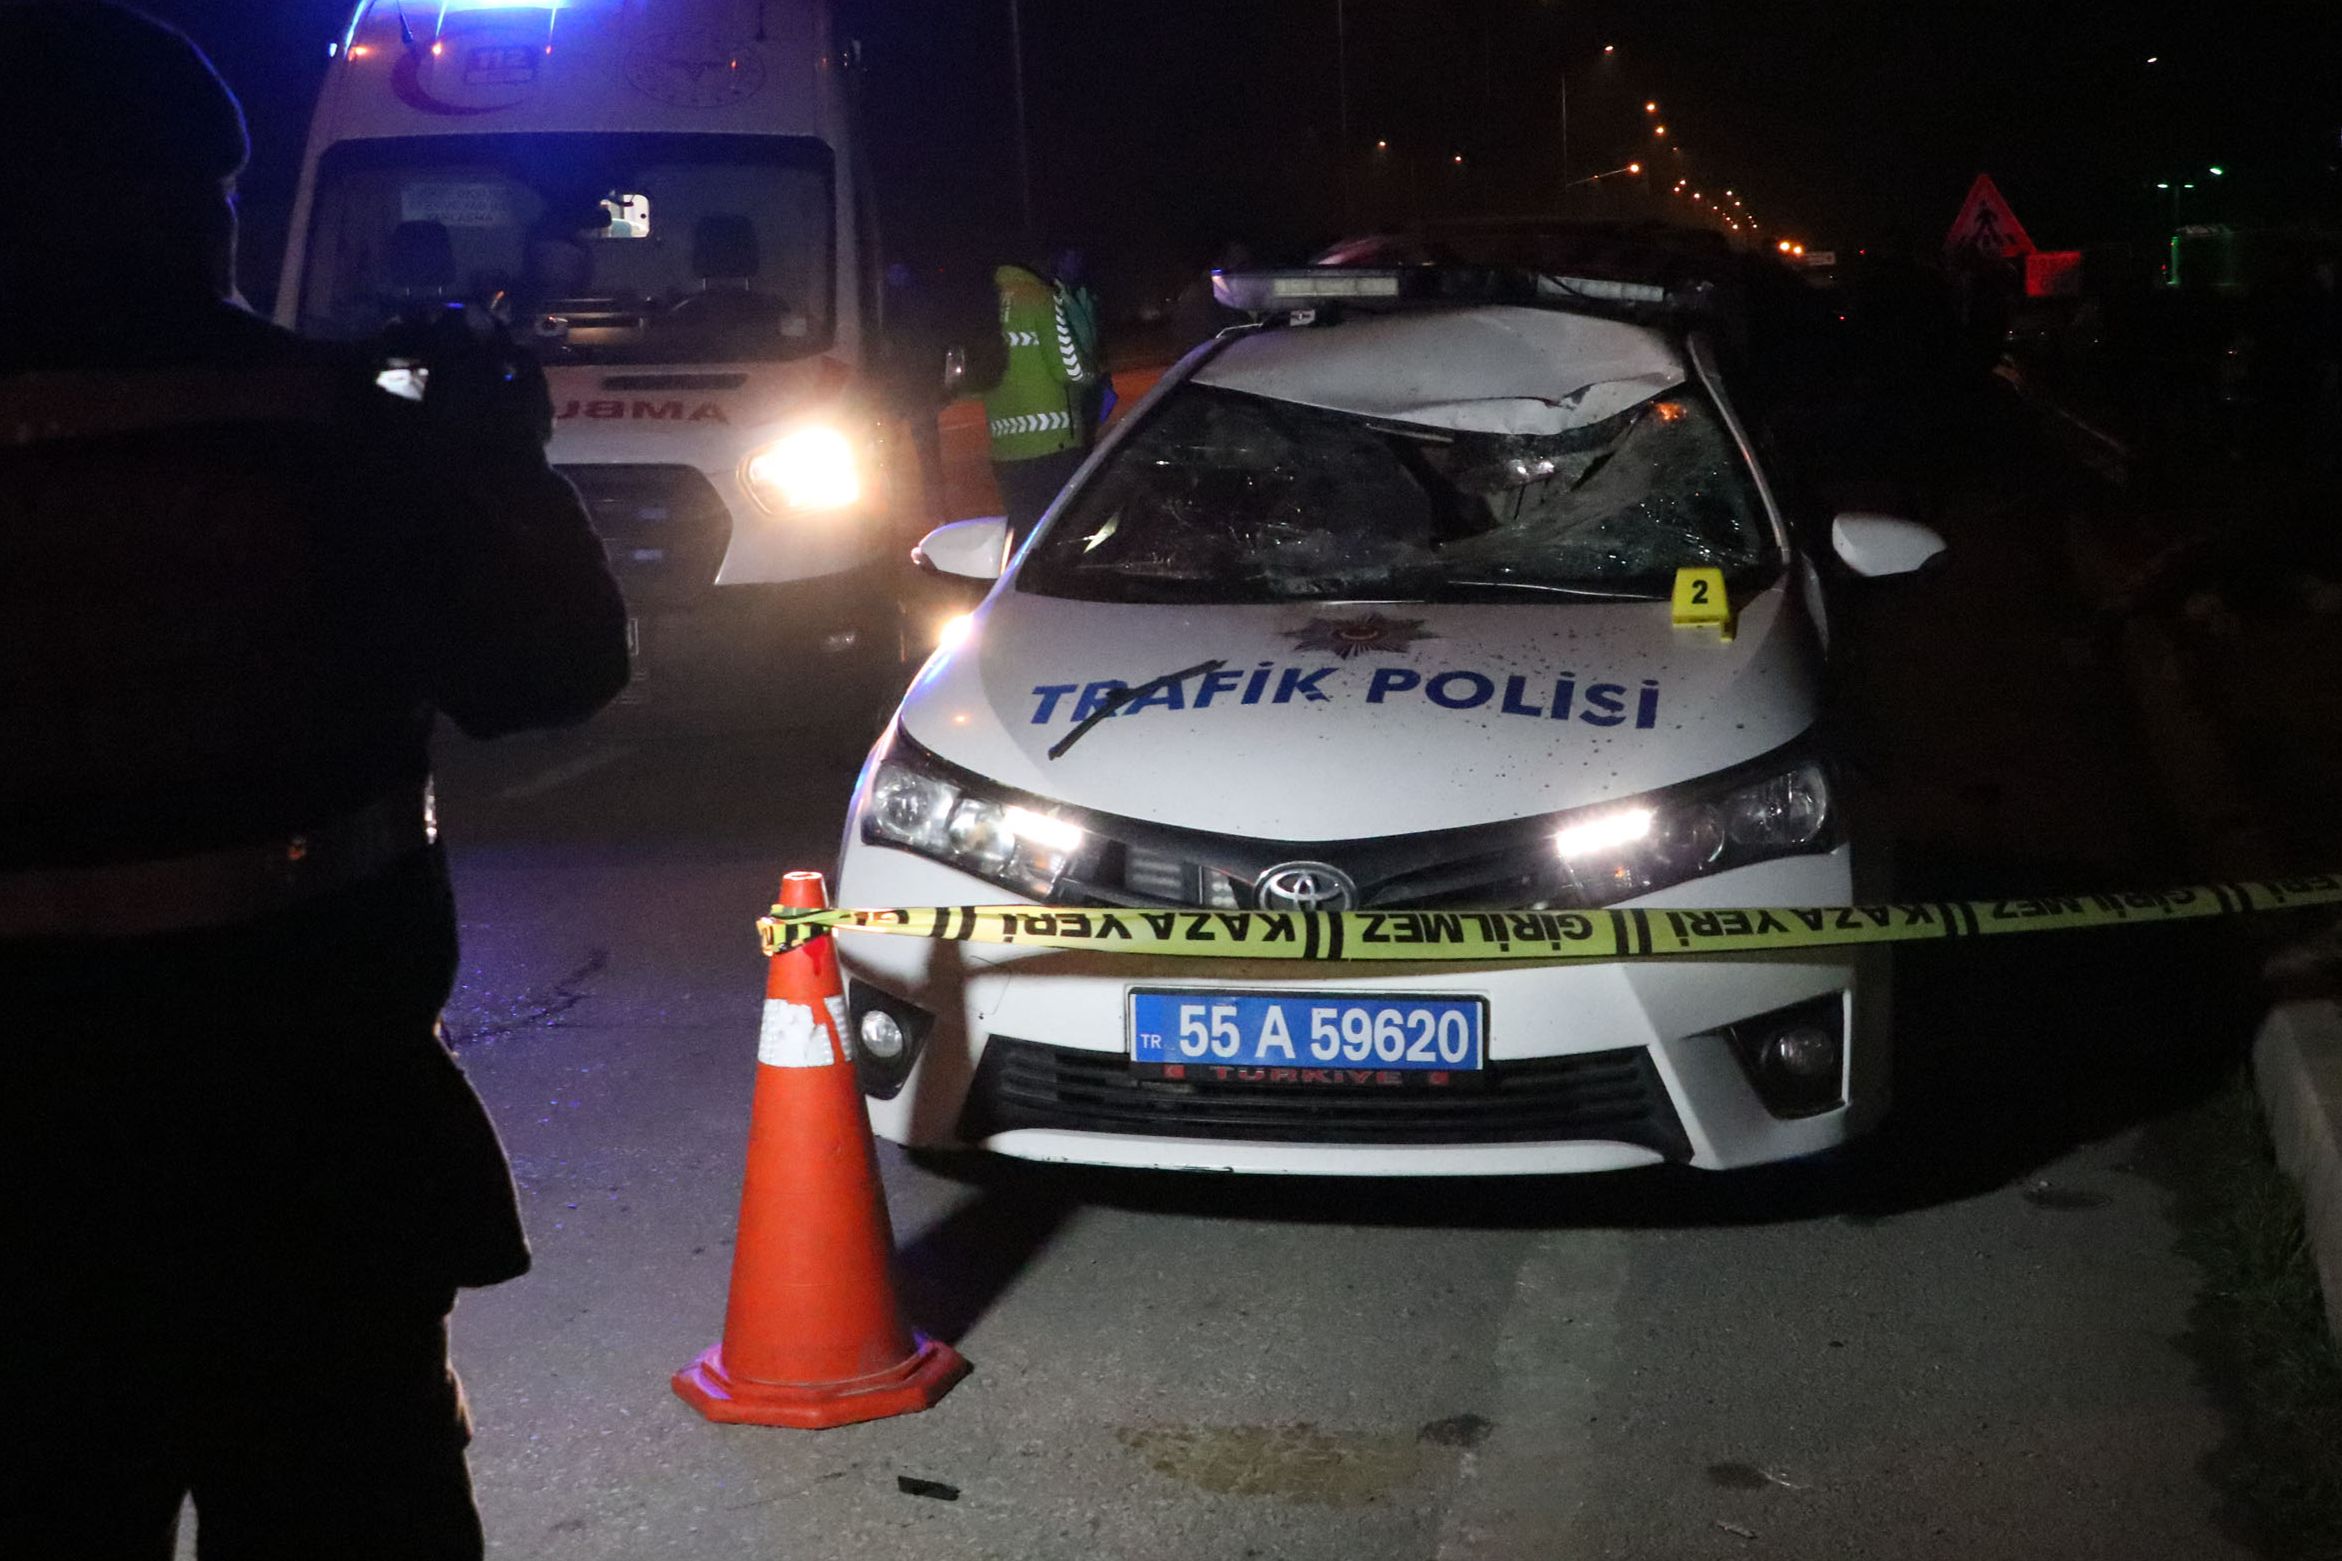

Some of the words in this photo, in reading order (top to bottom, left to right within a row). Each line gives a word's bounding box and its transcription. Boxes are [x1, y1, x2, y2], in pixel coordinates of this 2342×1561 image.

[1691, 579, 1709, 605] 2
[1031, 661, 1340, 724] TRAFİK
[1366, 668, 1659, 729] POLİSİ
[1003, 911, 1133, 943] YERİ
[1140, 911, 1296, 942] KAZA
[1355, 911, 1593, 952] GİRİLMEZ
[1666, 909, 1791, 947] YERİ
[1787, 903, 1934, 931] KAZA
[1140, 1034, 1161, 1049] TR
[1179, 1005, 1240, 1057] 55
[1255, 1005, 1296, 1059] A
[1310, 1007, 1469, 1063] 59620
